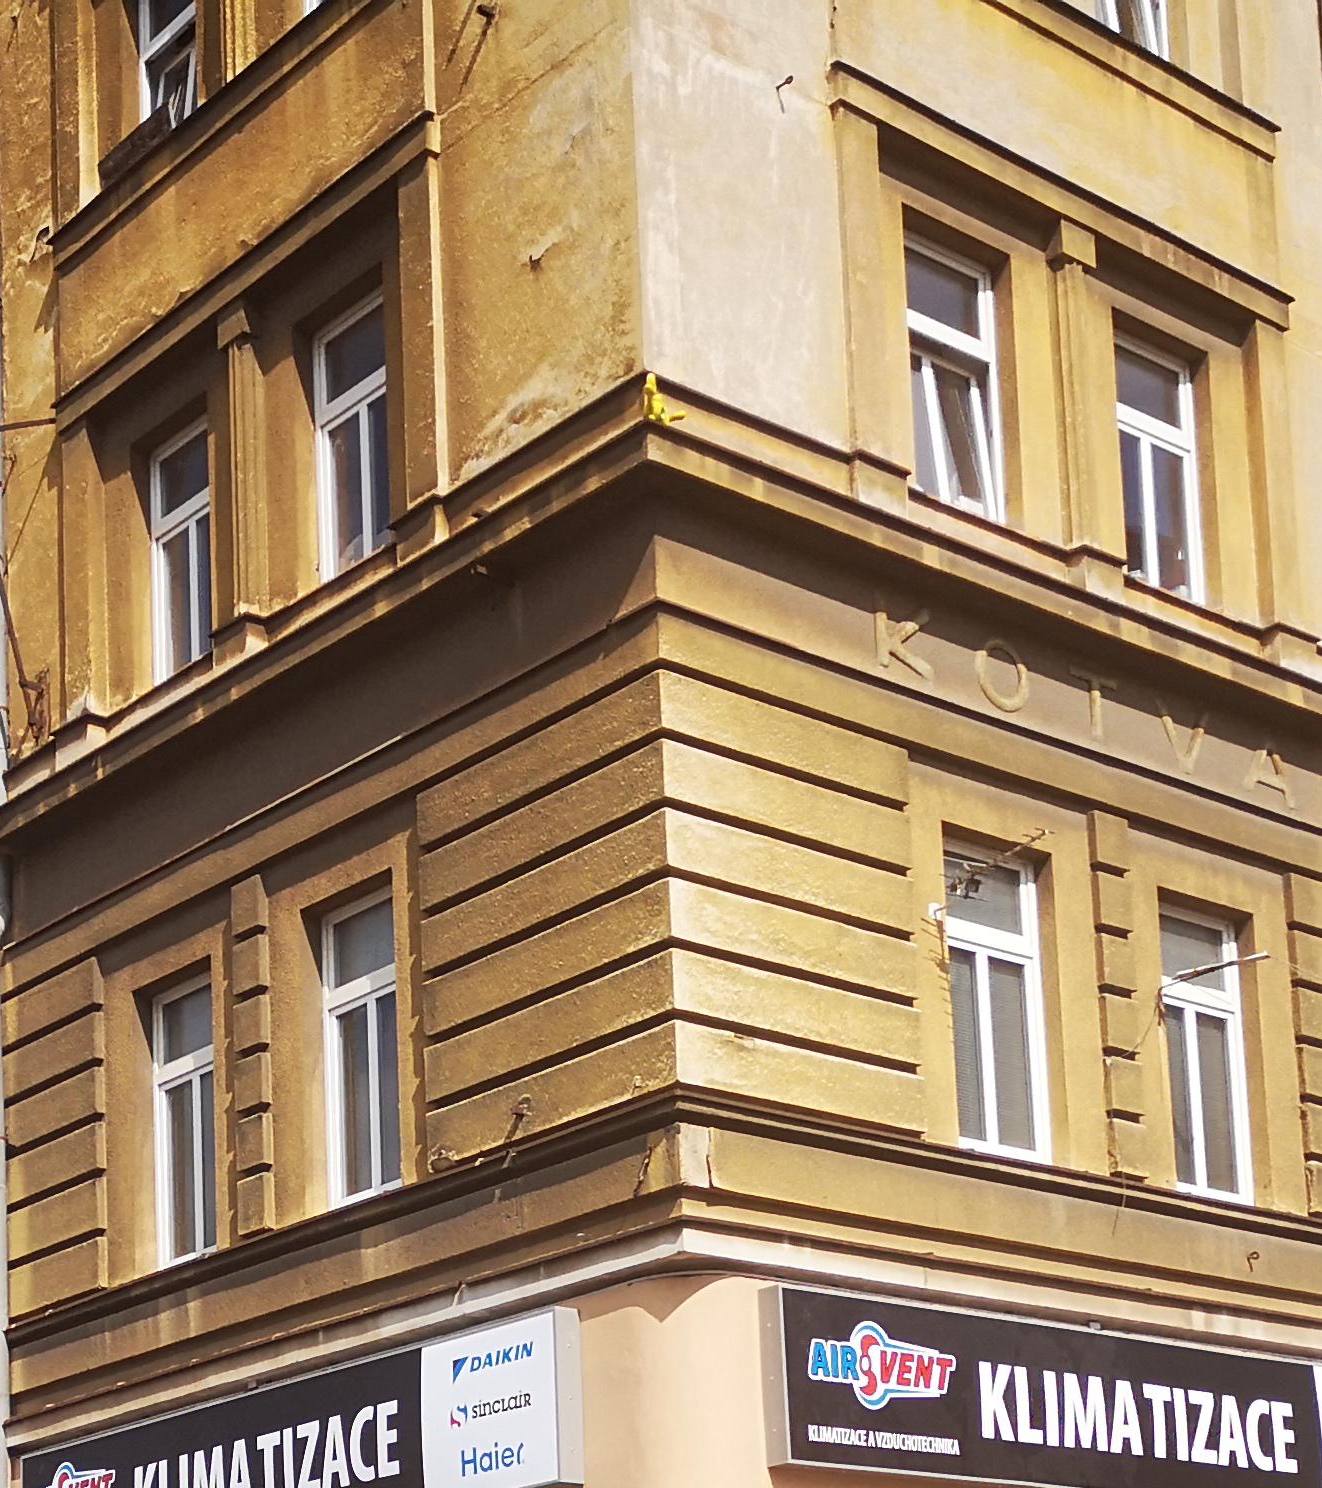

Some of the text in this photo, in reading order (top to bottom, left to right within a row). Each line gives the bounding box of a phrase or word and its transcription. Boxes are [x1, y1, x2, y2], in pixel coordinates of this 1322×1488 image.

[875, 610, 1297, 811] KOTVA
[469, 1341, 534, 1373] DAIKIN
[811, 1339, 956, 1393] AIR VENT
[808, 1424, 867, 1447] KLIMATIZACE
[978, 1360, 1299, 1475] KLIMATIZACE
[461, 1443, 525, 1478] Haier
